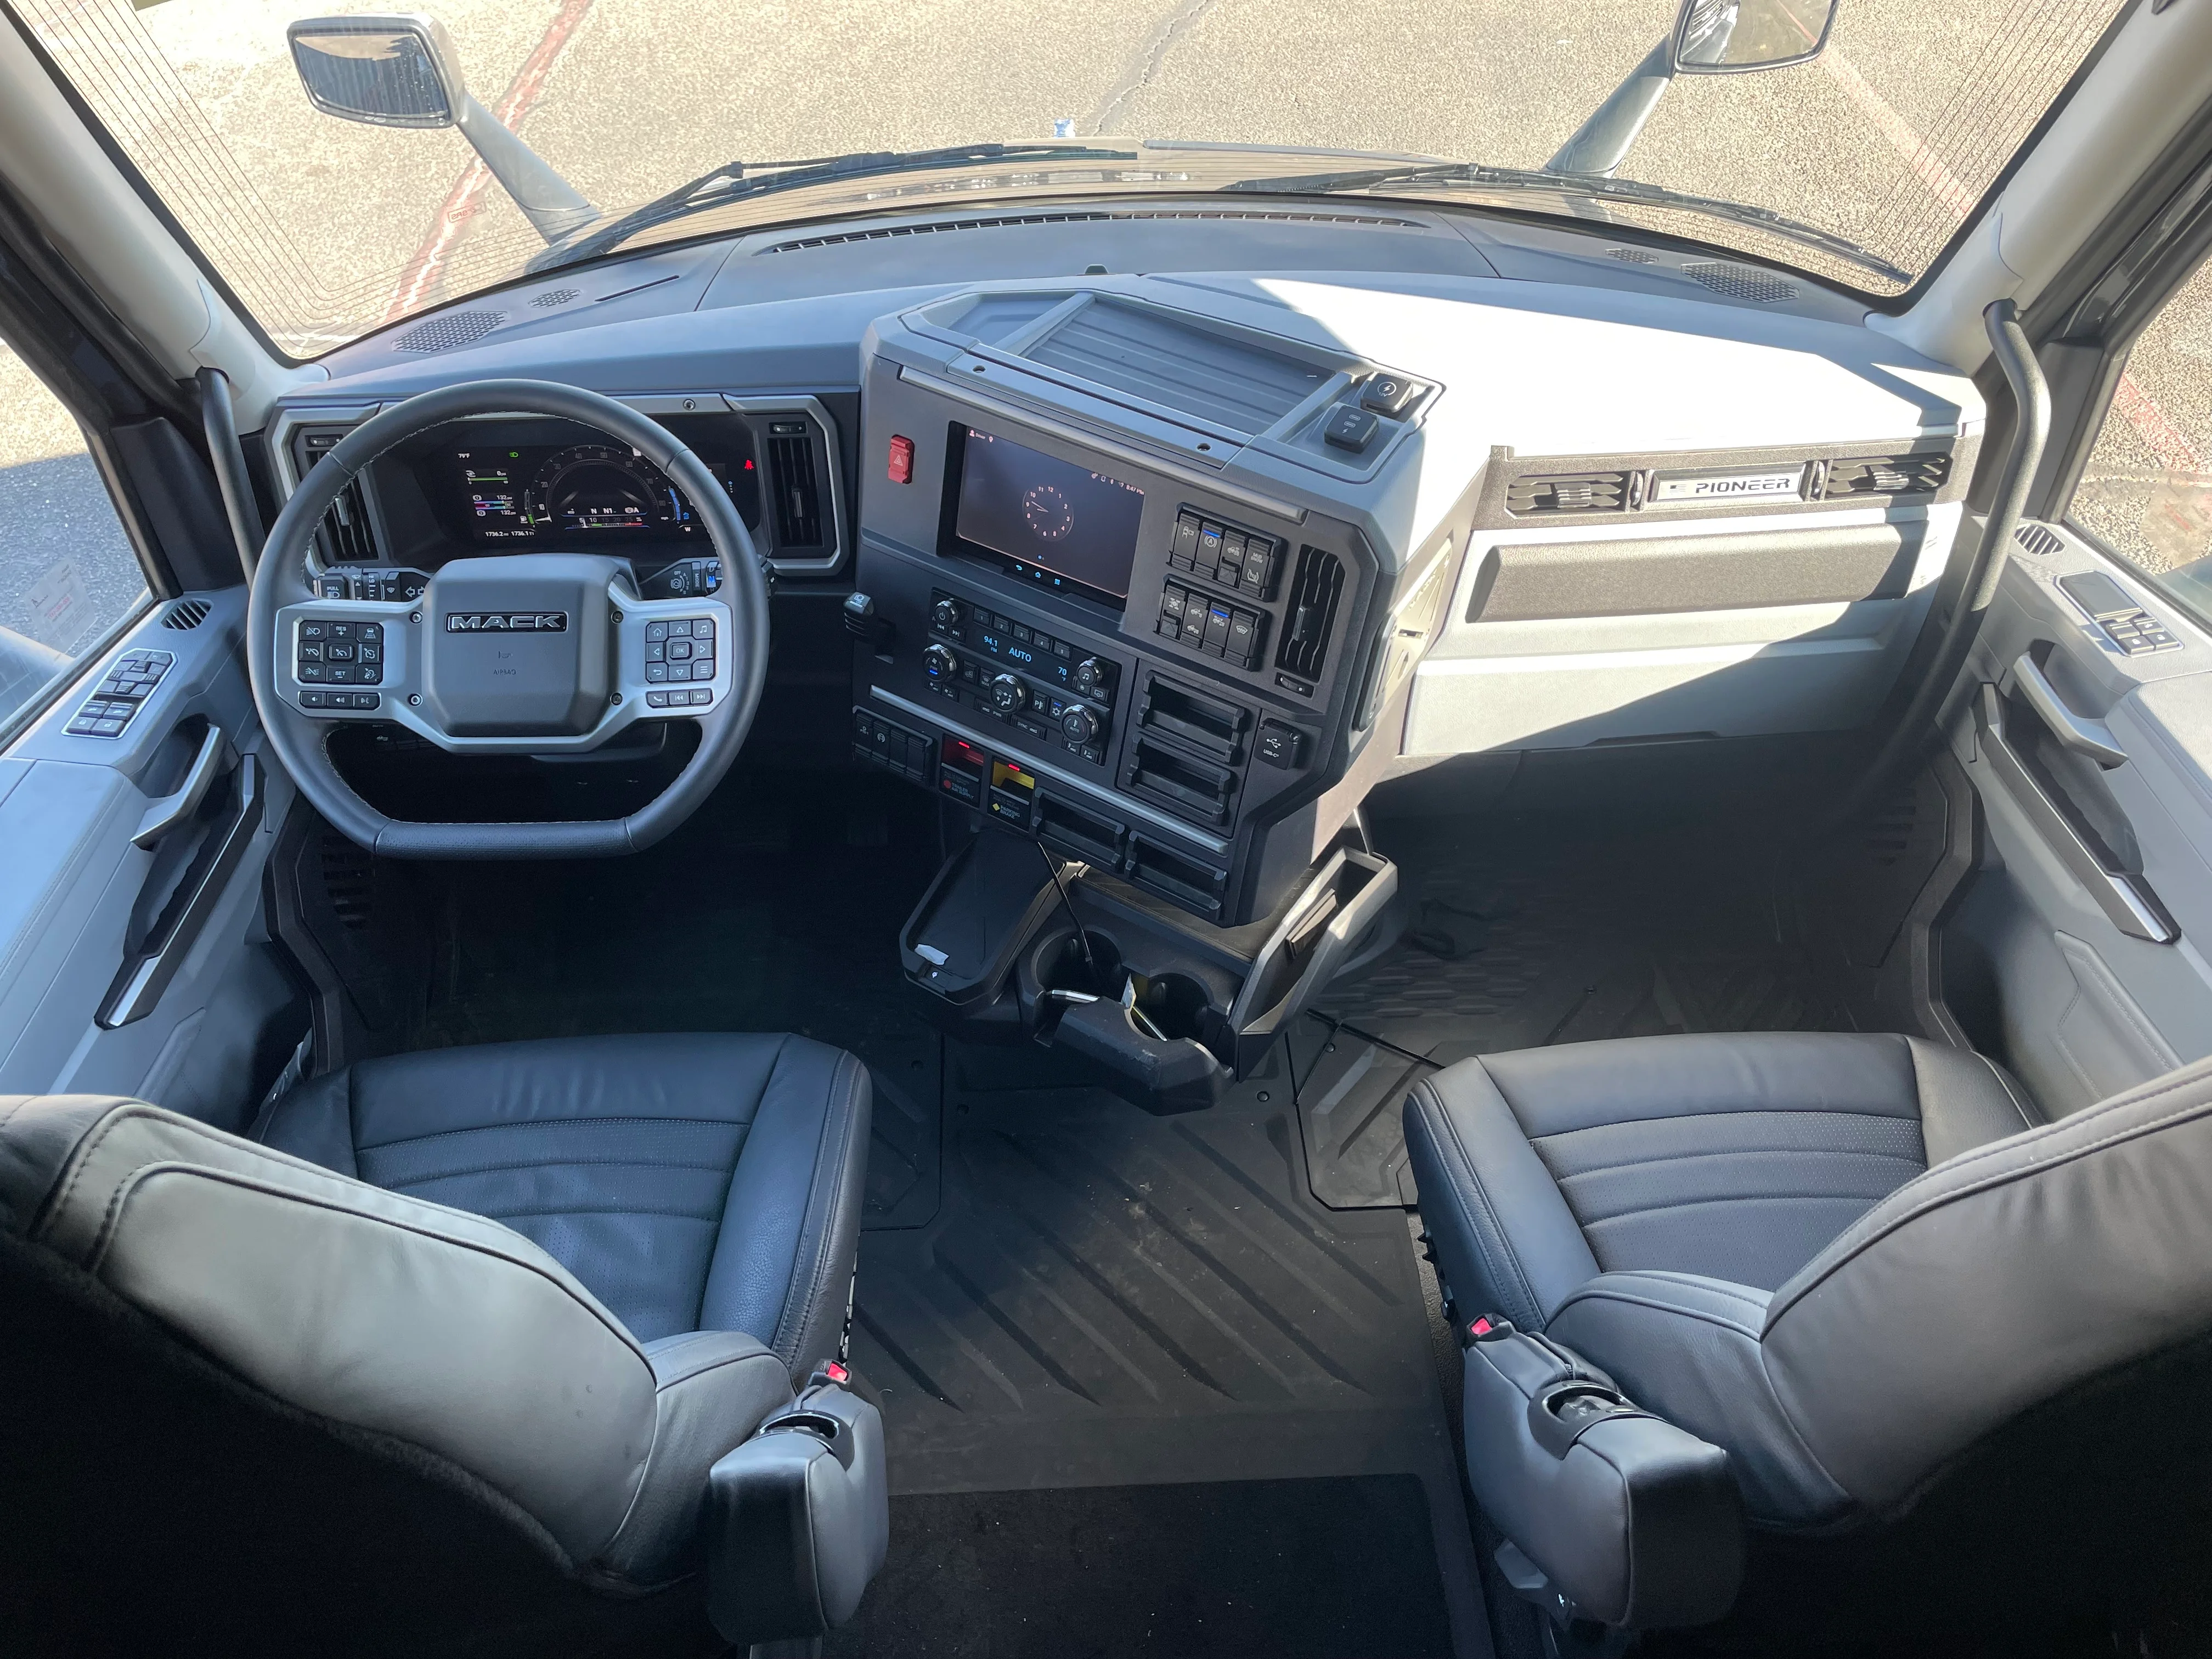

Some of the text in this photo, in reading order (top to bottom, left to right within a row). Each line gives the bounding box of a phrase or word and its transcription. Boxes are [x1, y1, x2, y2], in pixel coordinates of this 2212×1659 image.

[1695, 478, 1791, 494] PIONEER
[1250, 556, 1263, 564] SNOW
[451, 616, 561, 629] MACK
[984, 635, 998, 647] 94.1
[1008, 647, 1032, 662] AUTO
[1058, 666, 1067, 676] 70
[1017, 721, 1028, 730] SYNC
